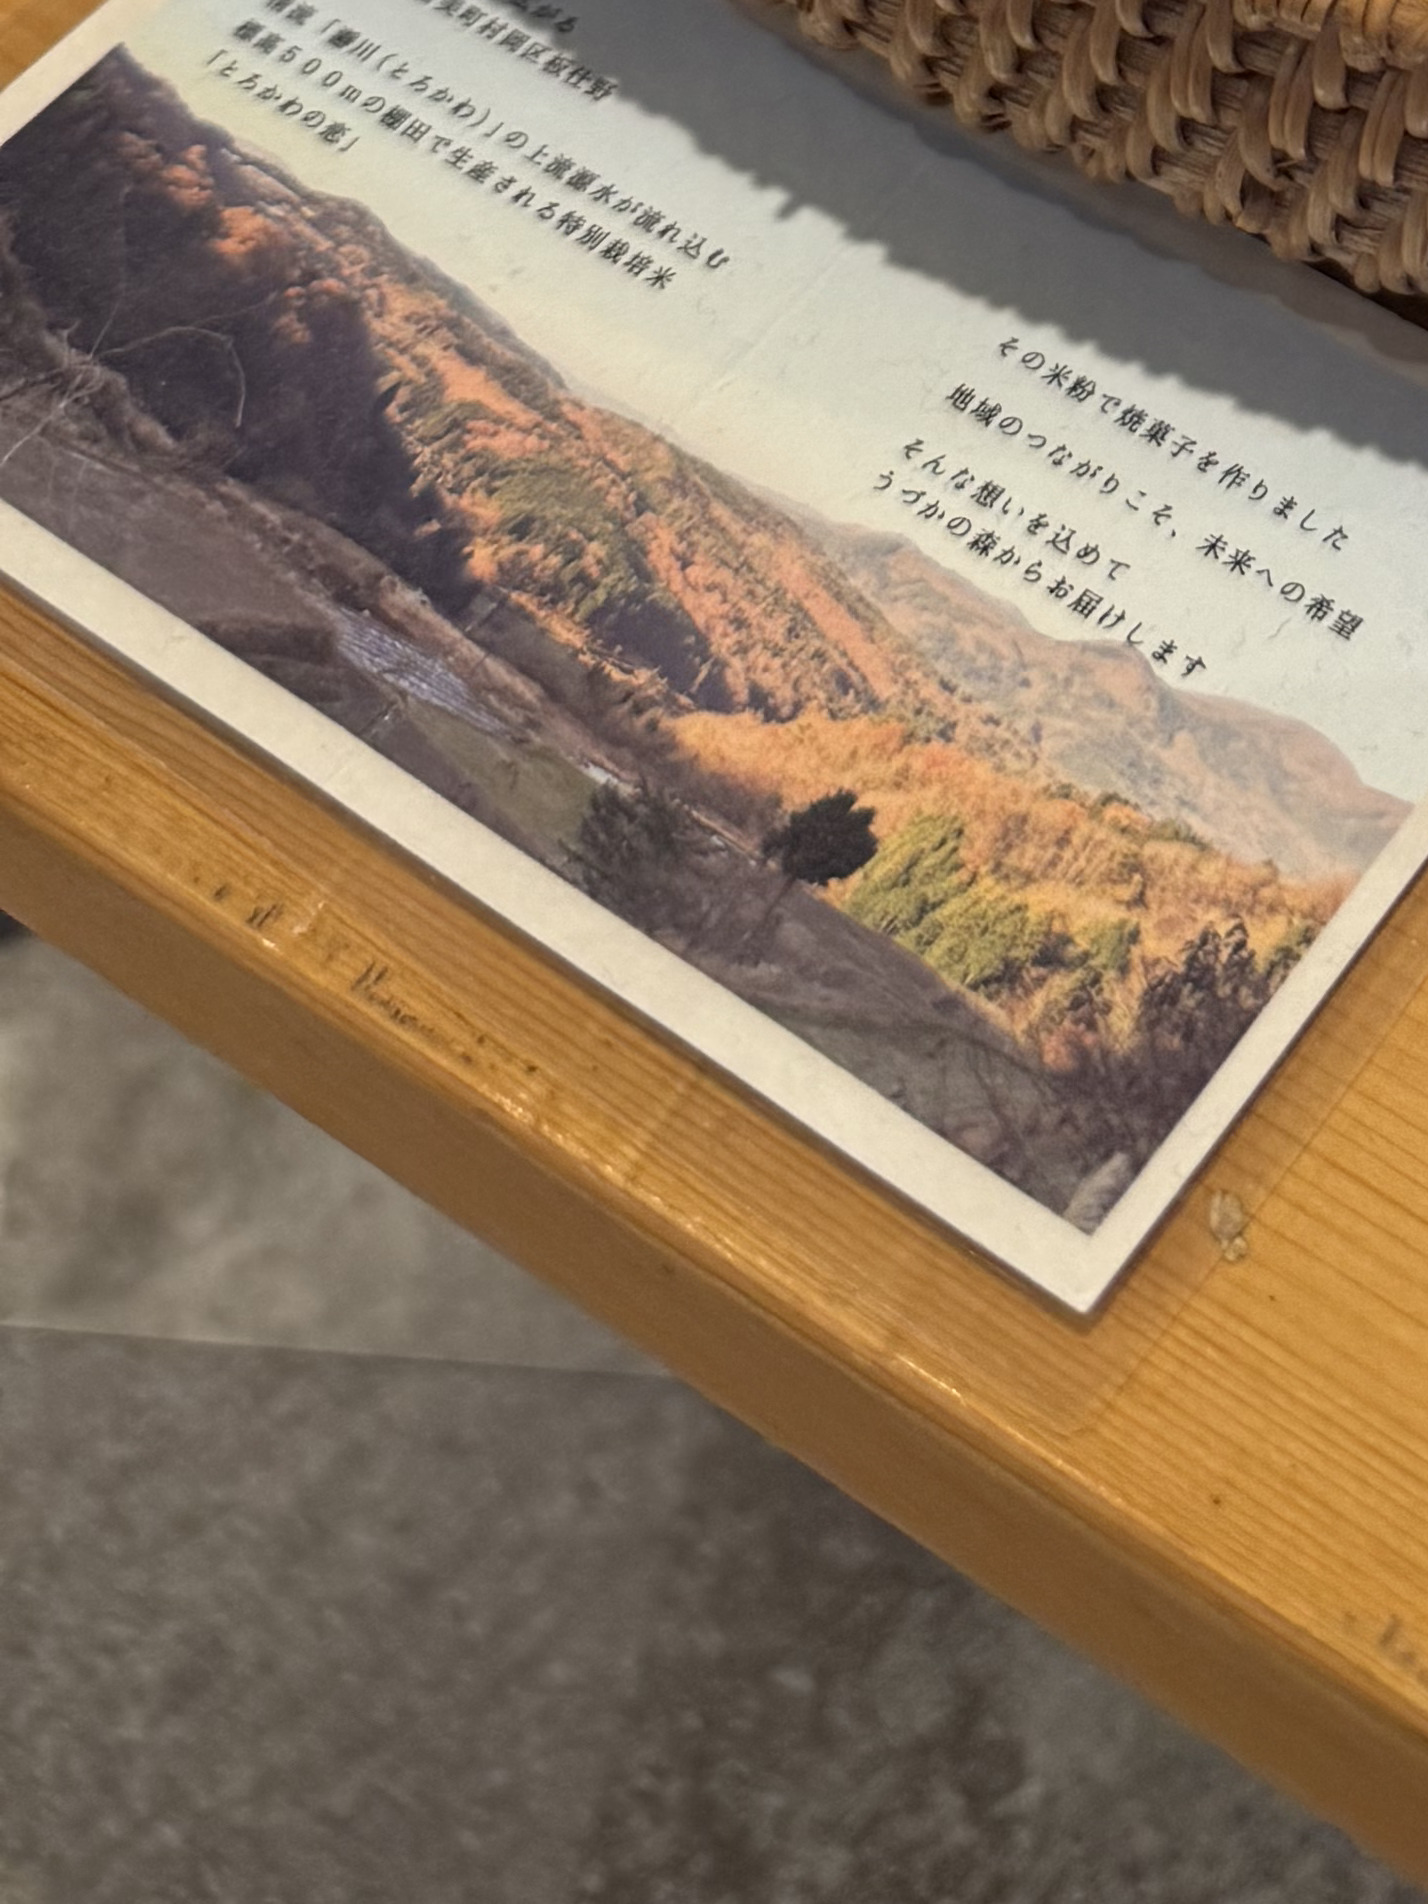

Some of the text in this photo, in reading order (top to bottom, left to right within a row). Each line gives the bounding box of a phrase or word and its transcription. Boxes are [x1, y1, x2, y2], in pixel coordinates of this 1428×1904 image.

[901, 437, 1132, 583] そんな想いを込めて
[945, 382, 1364, 642] 地域のつながりこそ、未来への希望
[998, 335, 1349, 553] その米粉で焼菓子を作りました
[872, 470, 1208, 679] うづかの森からお届けします
